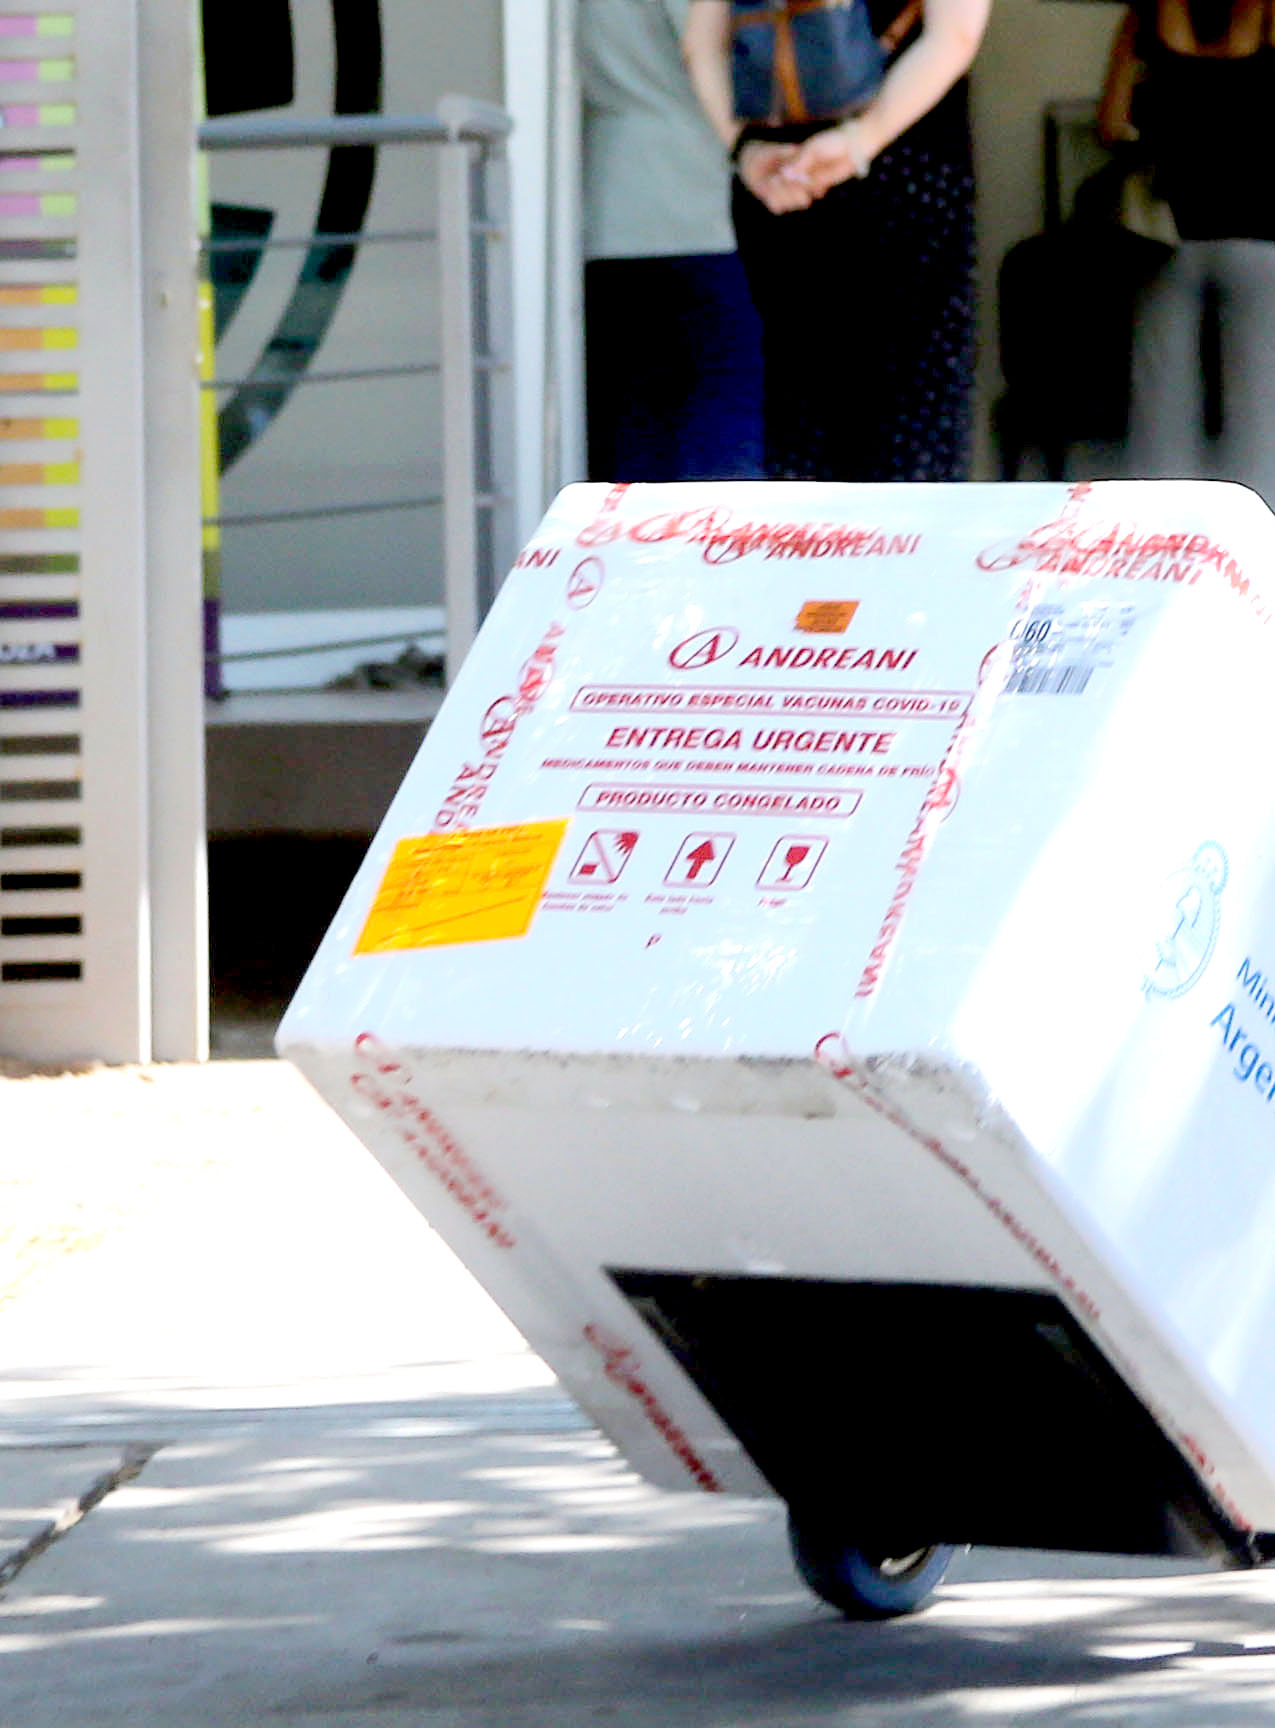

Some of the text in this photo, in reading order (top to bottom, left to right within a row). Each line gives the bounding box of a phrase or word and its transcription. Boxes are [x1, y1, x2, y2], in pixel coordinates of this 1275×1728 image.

[739, 646, 920, 671] ANDREANI
[583, 692, 684, 707] OPERATIVO
[688, 693, 774, 708] ESPECIAL
[783, 695, 868, 711] VACUNAS
[606, 727, 897, 754] ENTREGA URGENTE
[596, 791, 842, 811] PRODUCTO CONGELADO
